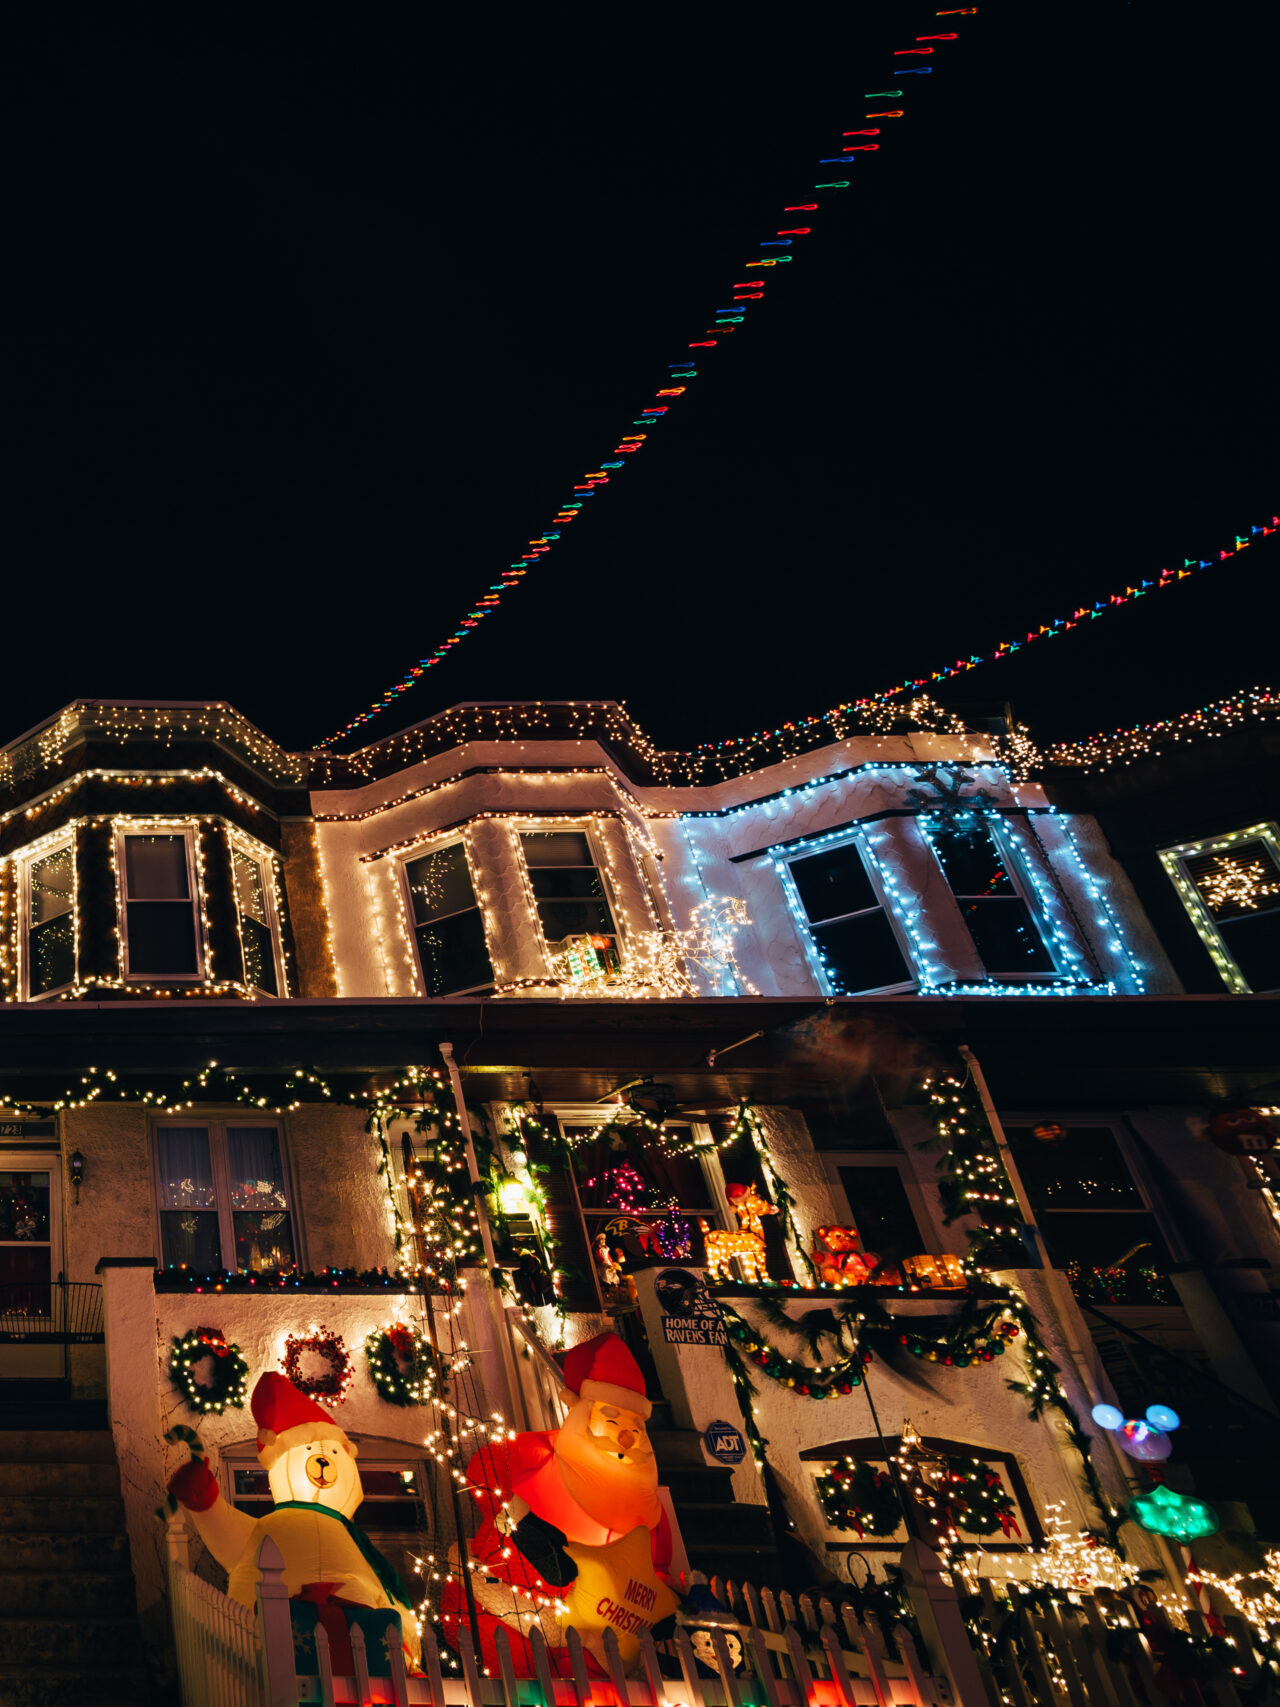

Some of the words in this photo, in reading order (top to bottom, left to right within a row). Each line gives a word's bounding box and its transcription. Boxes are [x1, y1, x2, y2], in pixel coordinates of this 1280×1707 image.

[665, 1317, 699, 1330] HOME
[700, 1319, 715, 1331] OF
[716, 1320, 724, 1332] A
[665, 1328, 706, 1344] RAVENS
[709, 1331, 729, 1345] FAN
[716, 1435, 739, 1451] ADT
[624, 1579, 657, 1611] MERRY
